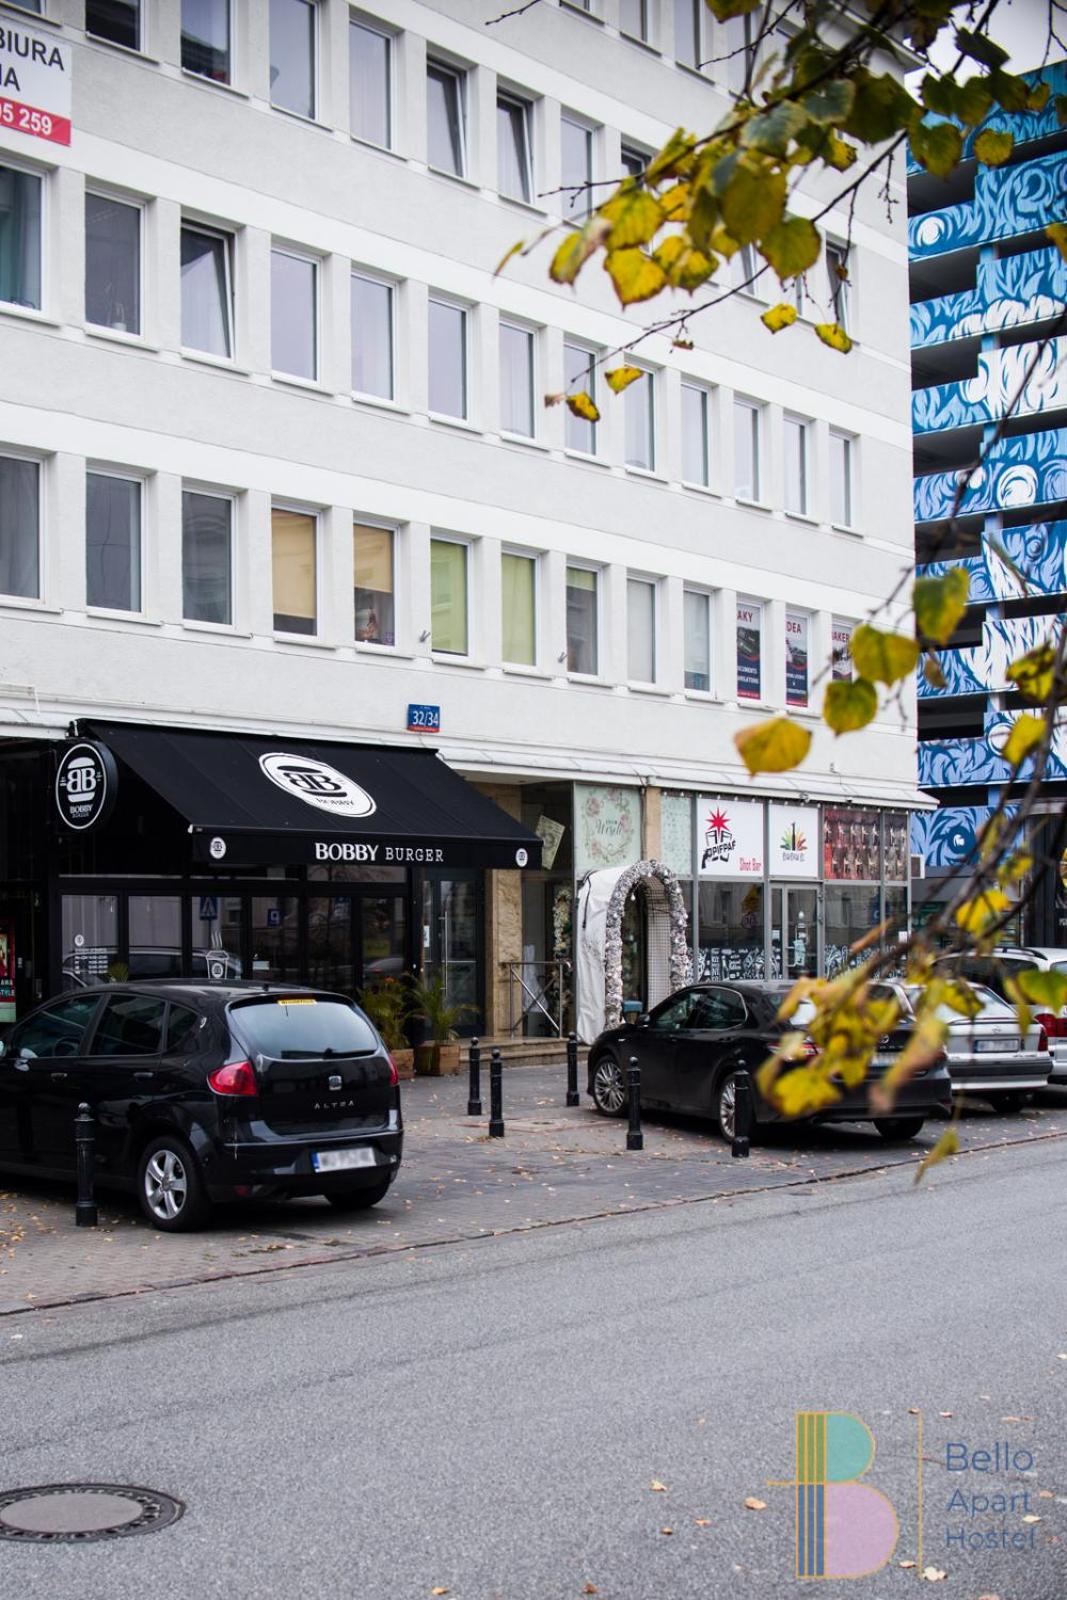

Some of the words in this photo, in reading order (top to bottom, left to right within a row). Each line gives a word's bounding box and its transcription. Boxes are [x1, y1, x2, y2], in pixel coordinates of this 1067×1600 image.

[0, 102, 13, 122] 5
[19, 108, 52, 135] 259
[412, 710, 439, 726] 32/34
[315, 842, 379, 861] BOBBY
[385, 847, 444, 862] BURGER
